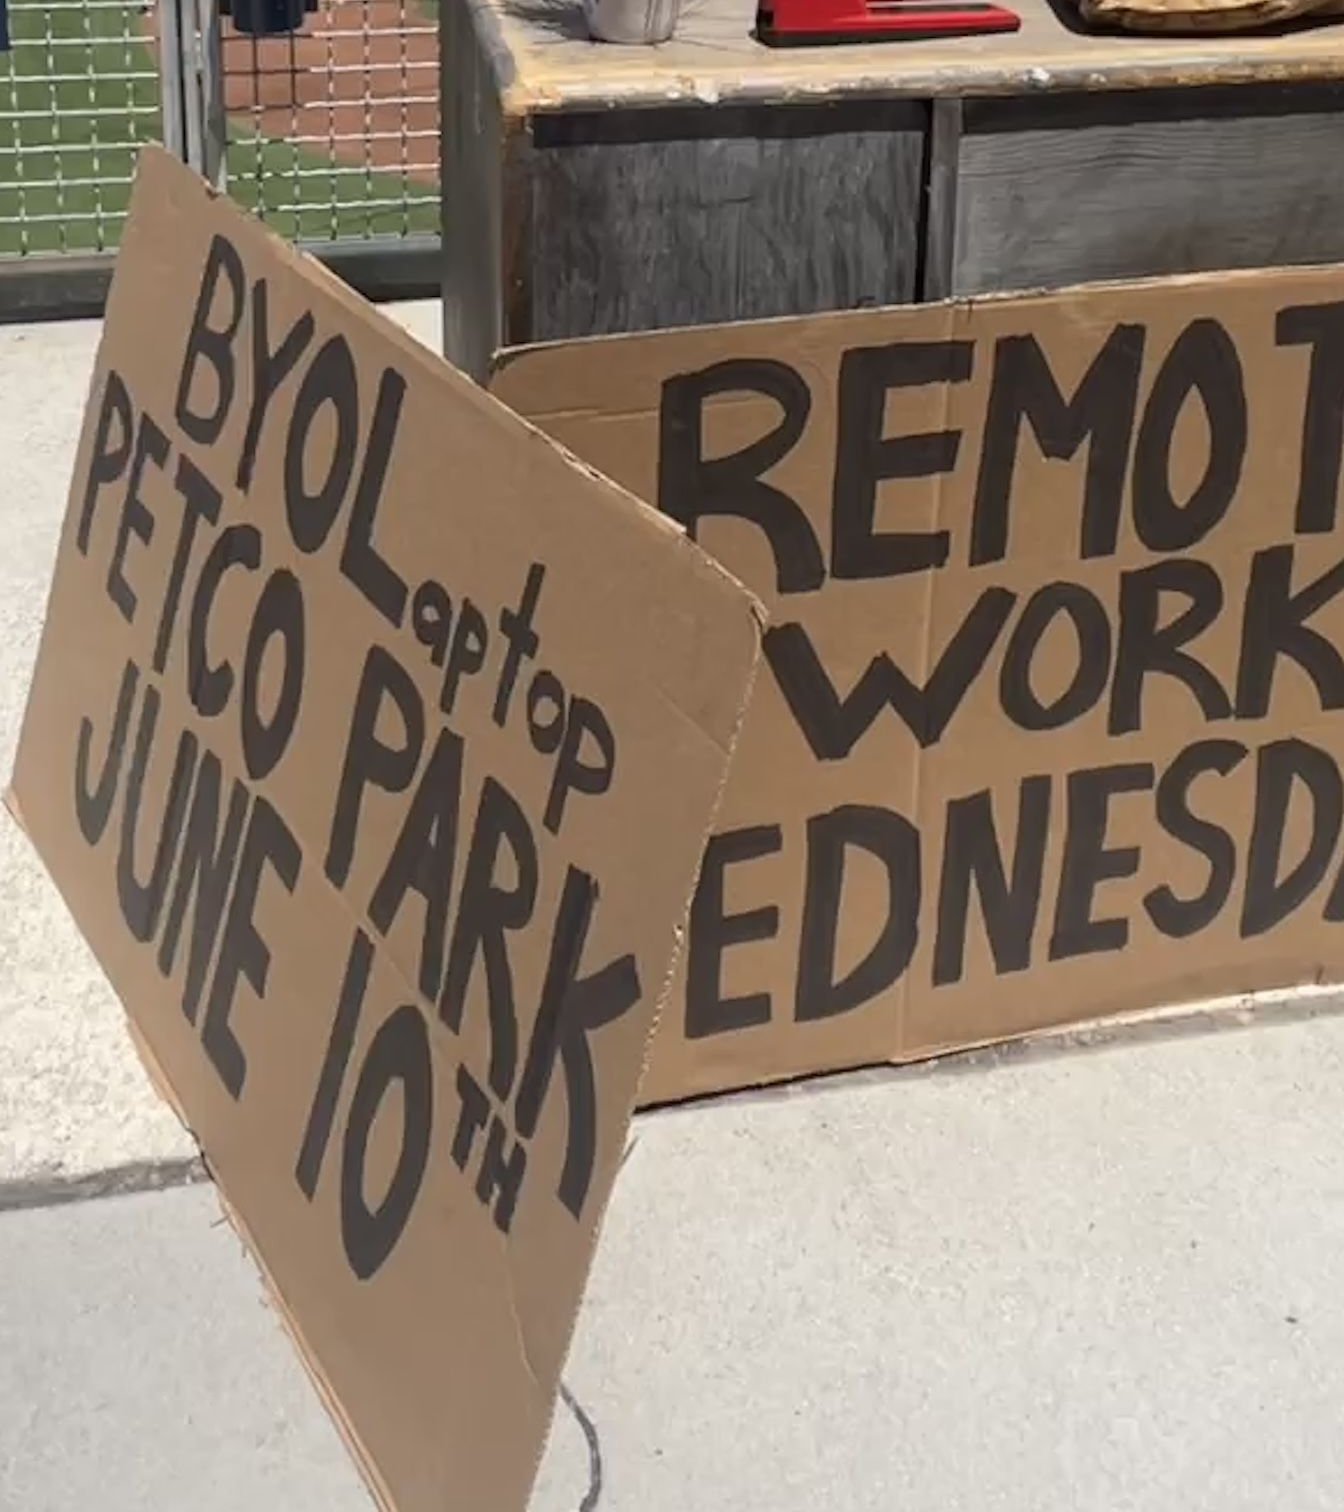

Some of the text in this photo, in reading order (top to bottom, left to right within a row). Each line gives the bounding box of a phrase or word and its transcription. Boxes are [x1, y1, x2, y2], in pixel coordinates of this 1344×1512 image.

[74, 658, 303, 1103] JUNE
[77, 369, 643, 1222] PETCO PARK
